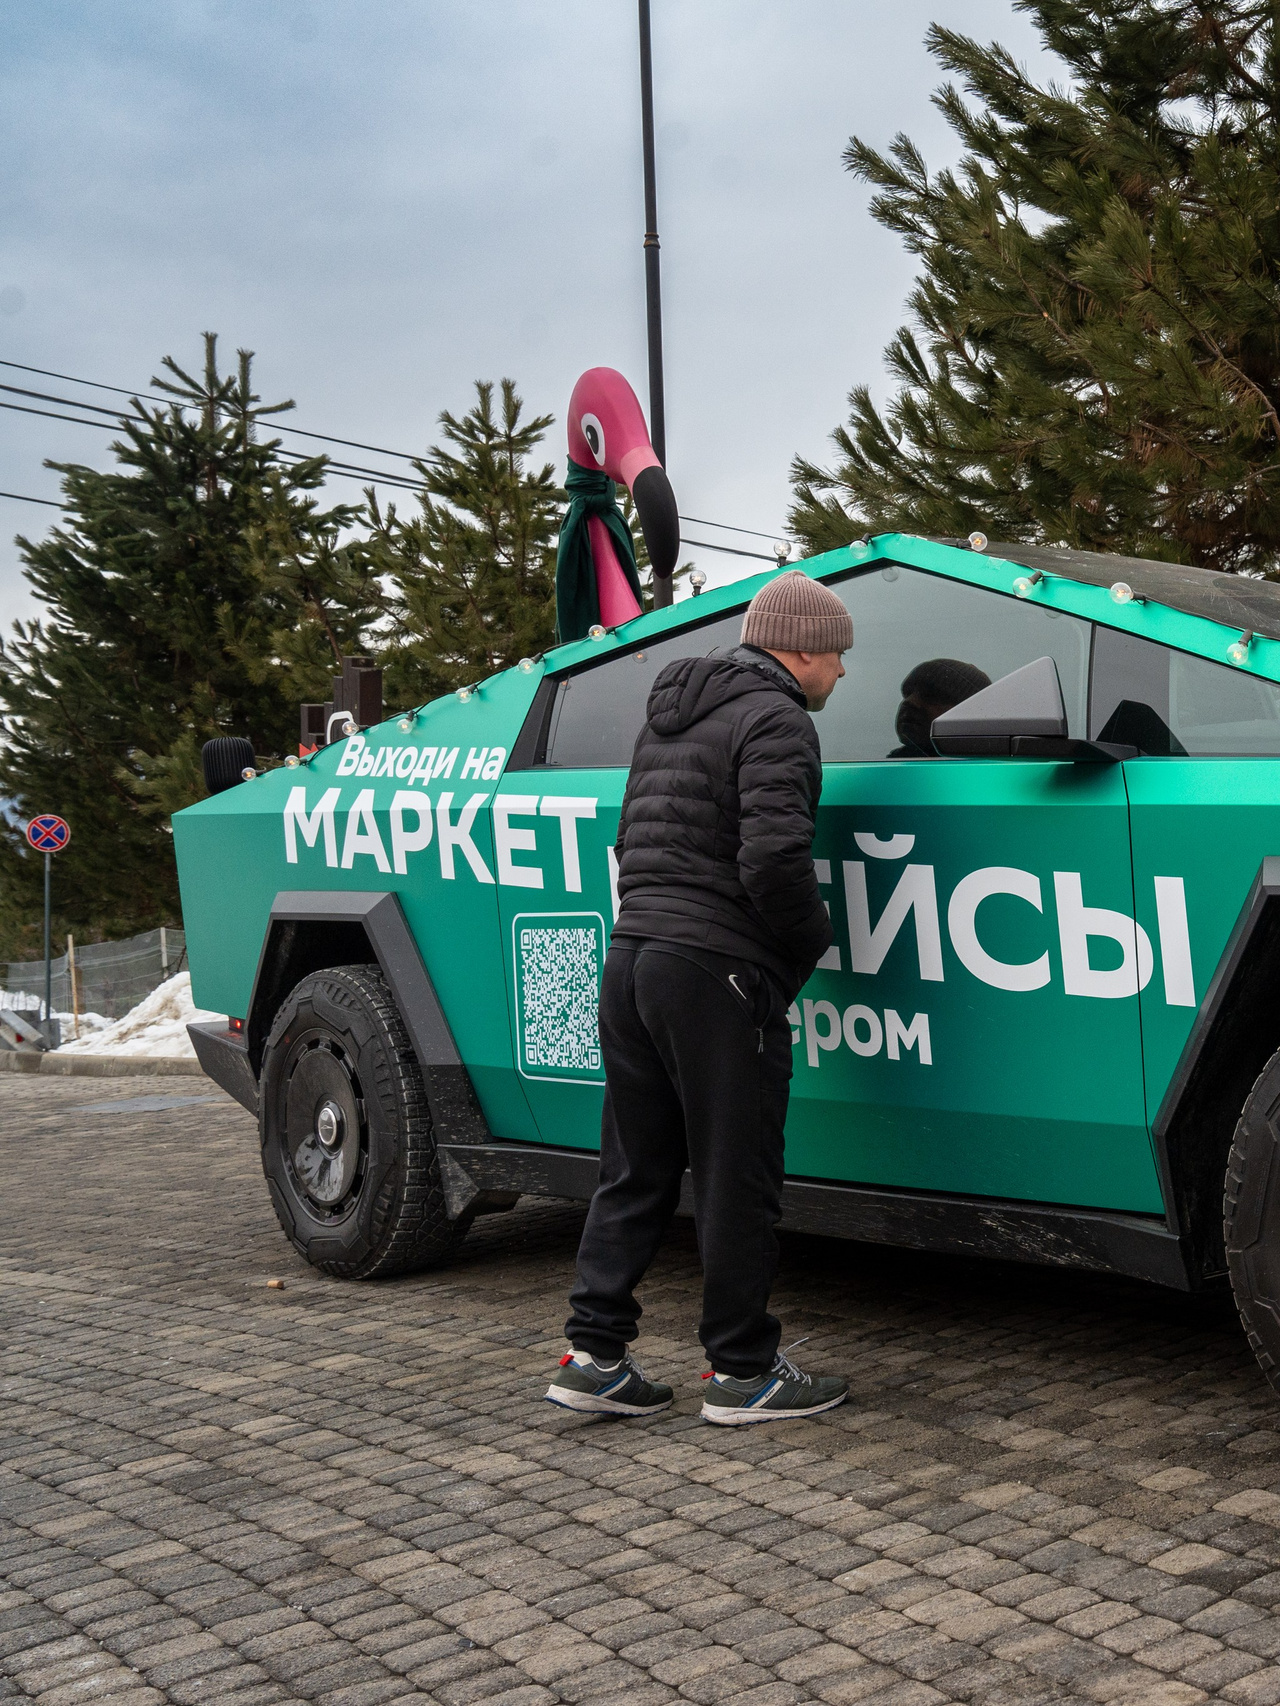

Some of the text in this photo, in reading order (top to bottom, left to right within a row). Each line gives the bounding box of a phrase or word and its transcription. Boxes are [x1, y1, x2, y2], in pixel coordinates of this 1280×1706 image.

[336, 736, 507, 786] Выходи на
[284, 786, 598, 893] МАРКЕТ
